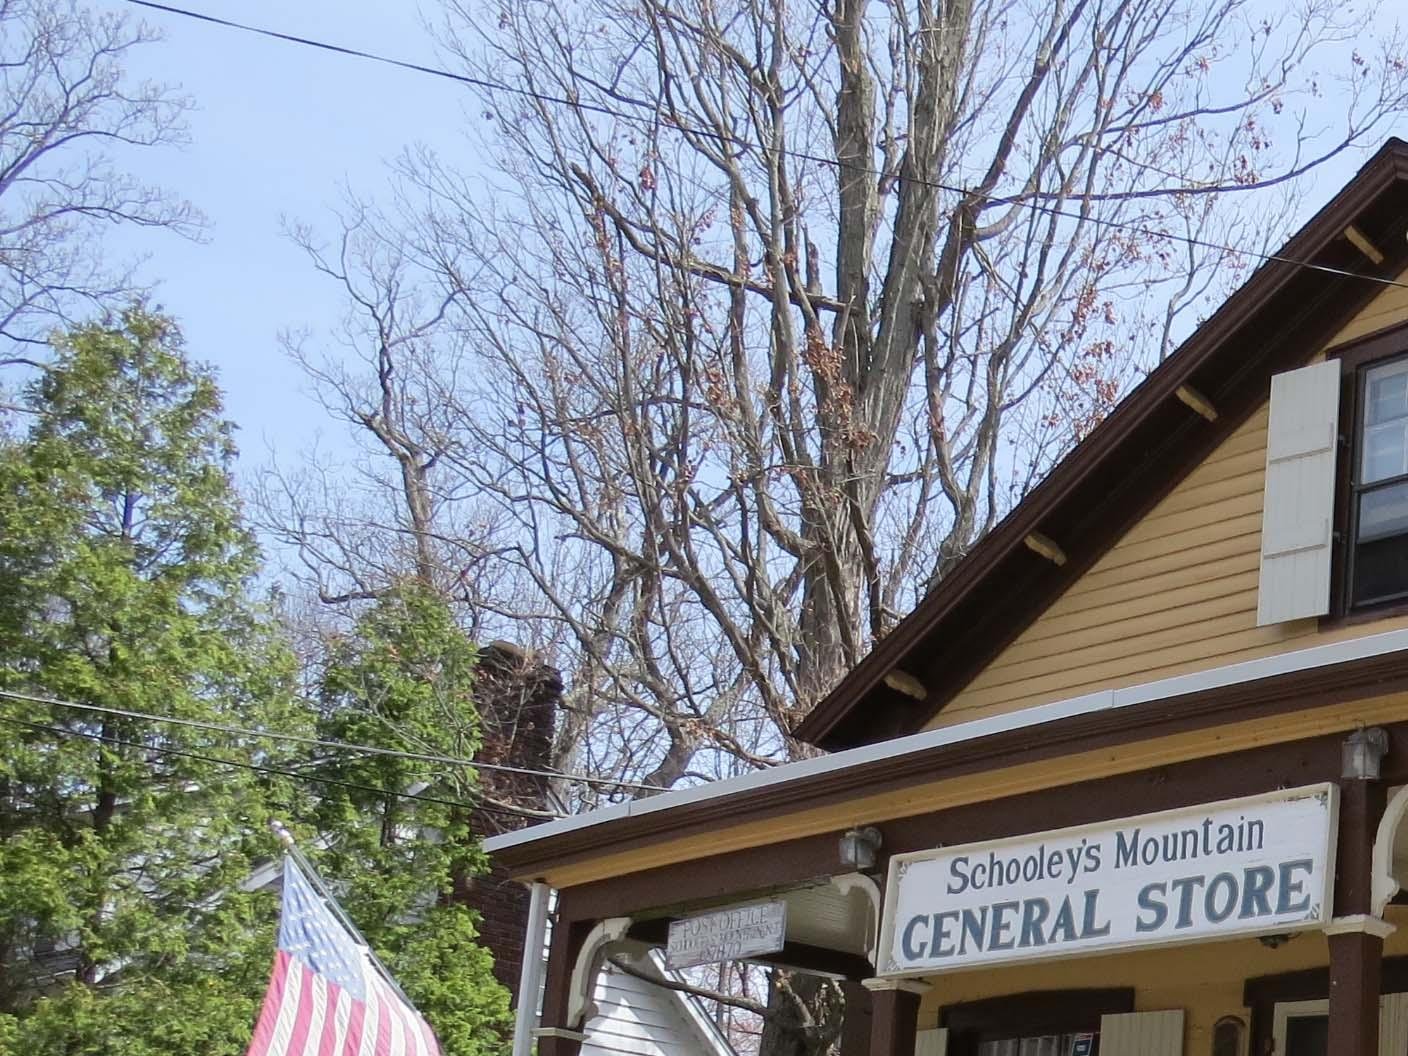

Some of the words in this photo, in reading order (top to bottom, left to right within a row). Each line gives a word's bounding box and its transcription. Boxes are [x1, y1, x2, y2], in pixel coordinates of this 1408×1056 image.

[946, 838, 1101, 894] Schooley's
[1114, 816, 1264, 869] Mountain
[683, 918, 717, 938] POST
[719, 905, 769, 931] OFFICE
[901, 889, 1110, 962] GENERAL
[1136, 858, 1314, 933] STORE
